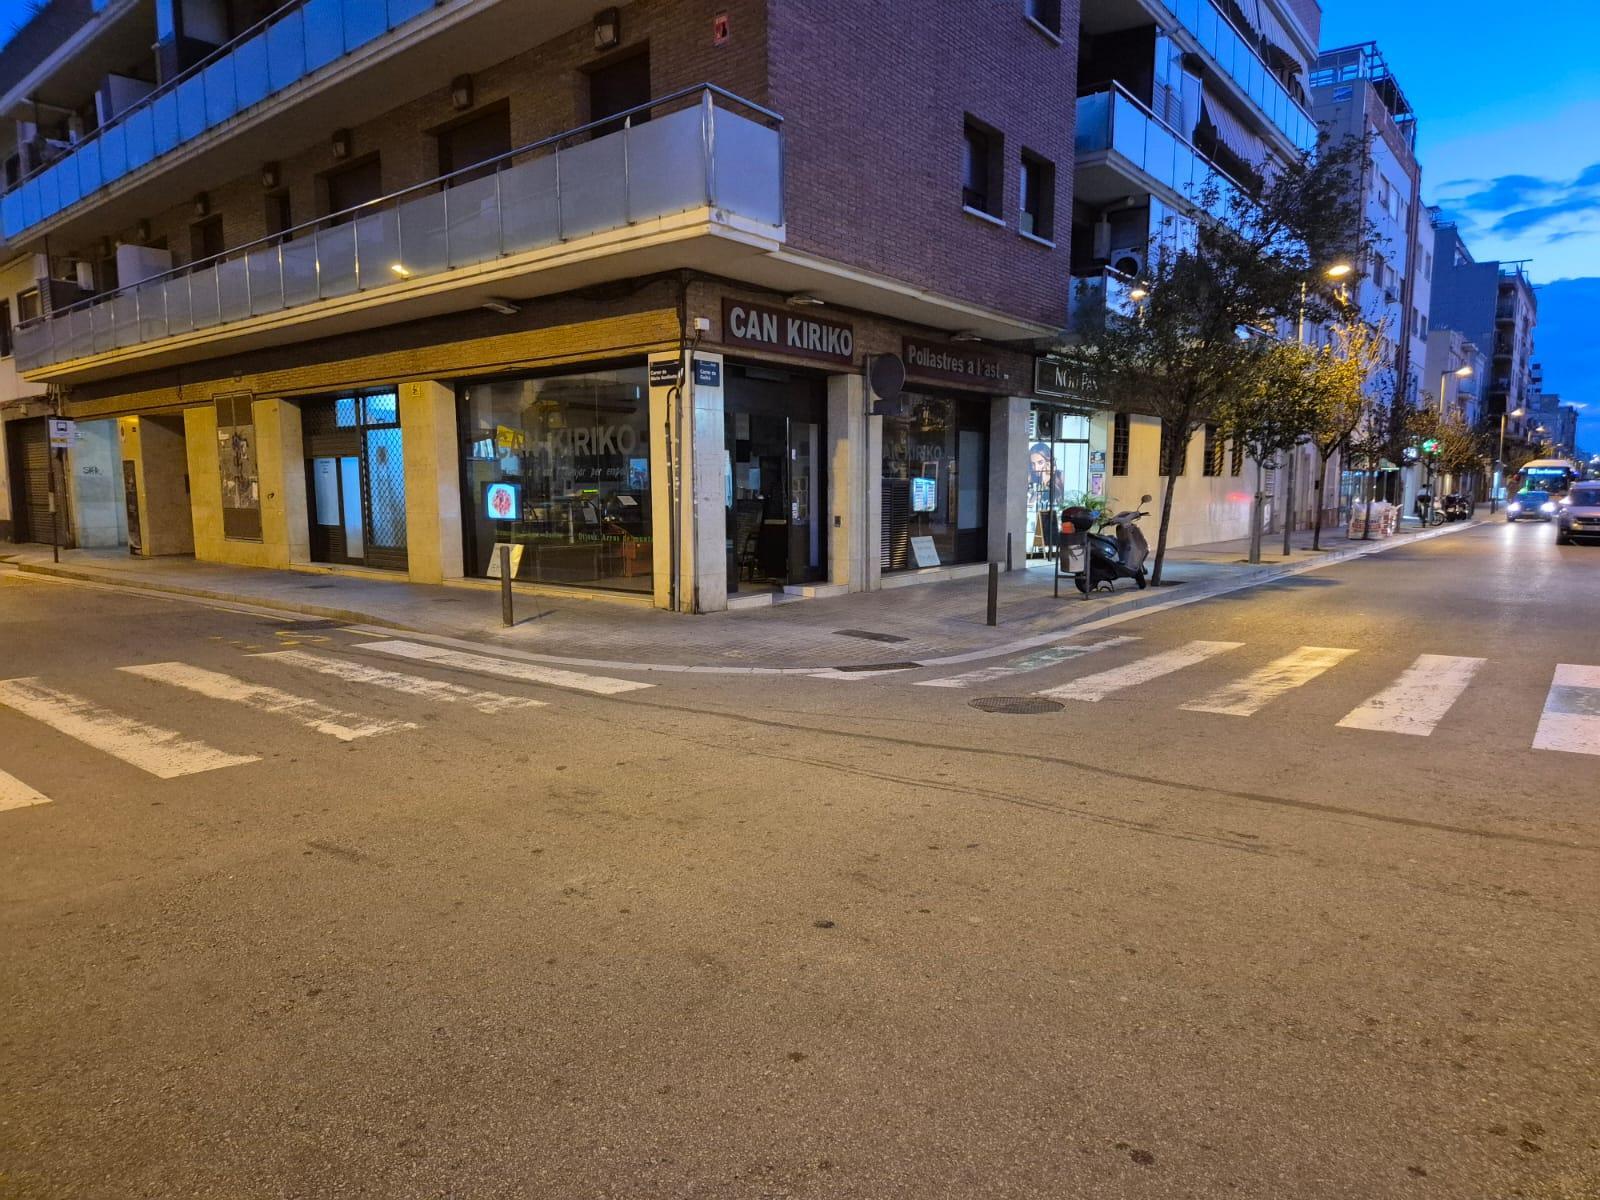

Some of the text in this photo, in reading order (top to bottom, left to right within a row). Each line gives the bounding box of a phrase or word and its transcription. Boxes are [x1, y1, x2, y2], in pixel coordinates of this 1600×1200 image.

[730, 306, 853, 357] CAN KIRIKO
[908, 344, 964, 373] Pollastres
[967, 360, 975, 375] a
[552, 423, 637, 457] KIRIKO
